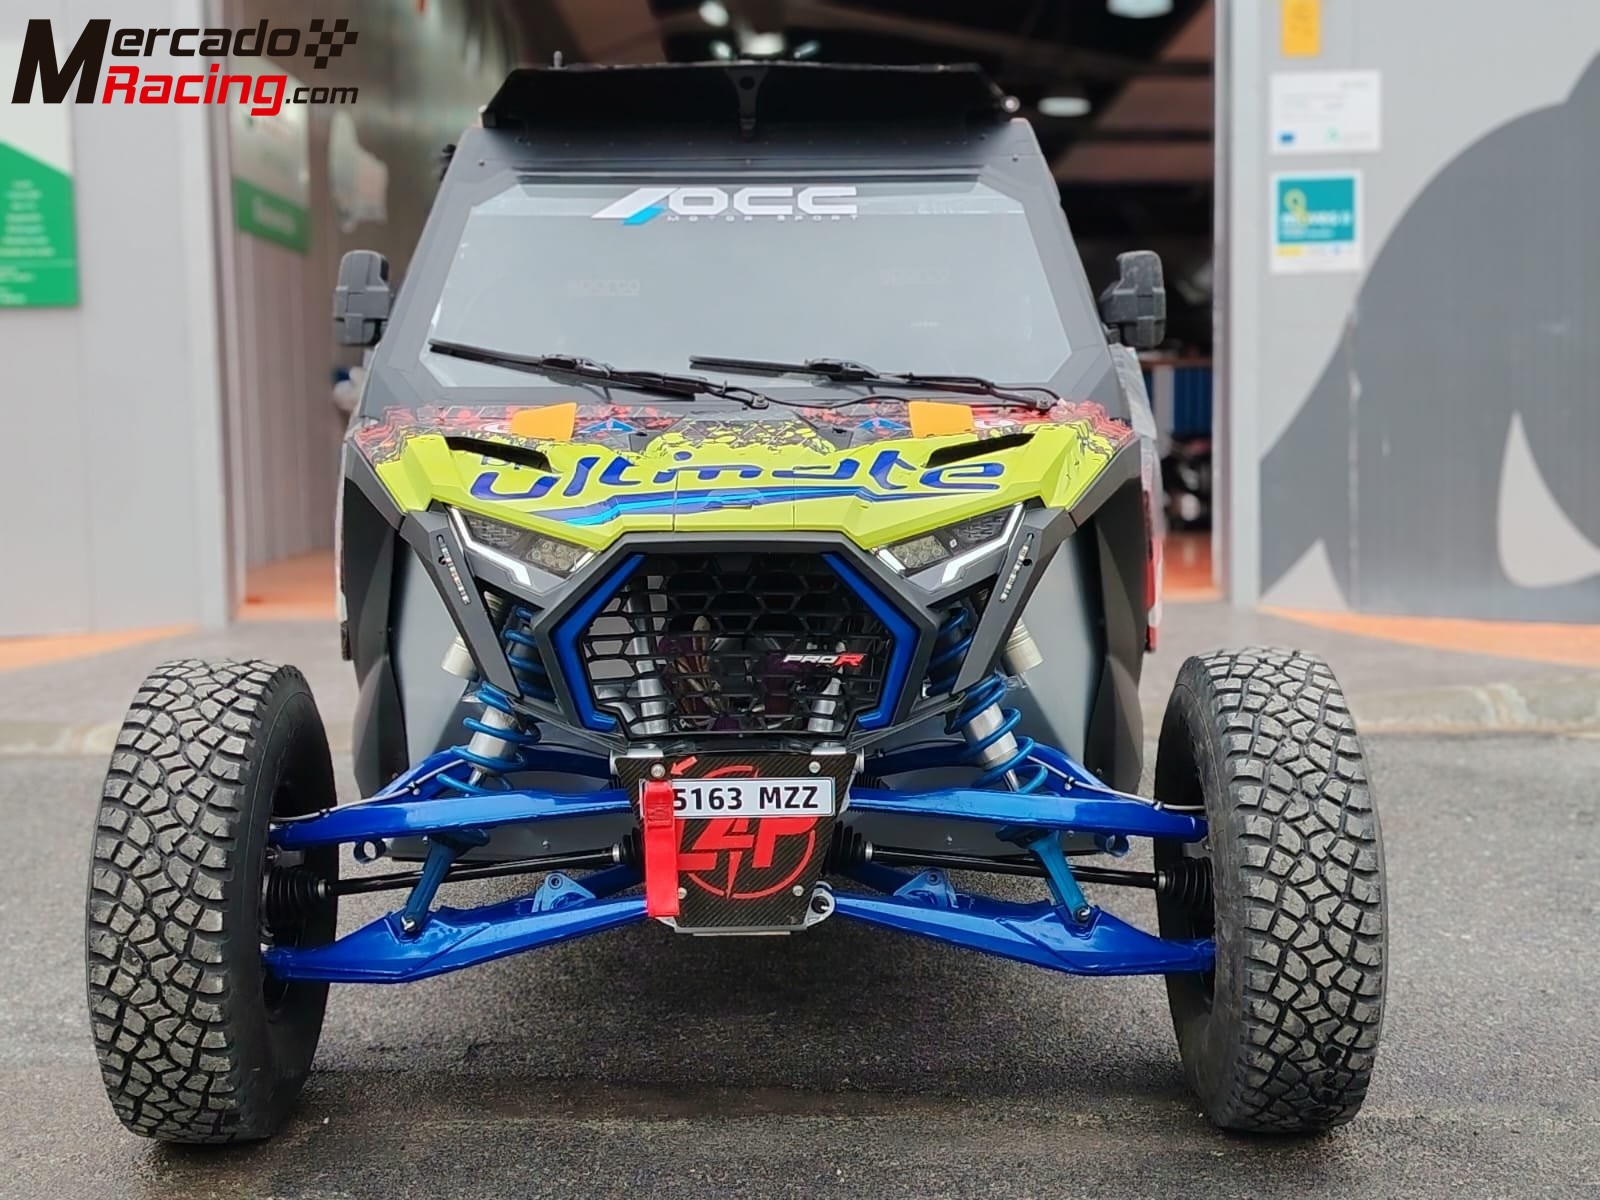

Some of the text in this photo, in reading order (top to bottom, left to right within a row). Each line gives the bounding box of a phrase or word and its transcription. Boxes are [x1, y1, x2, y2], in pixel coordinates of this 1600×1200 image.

[668, 187, 857, 215] OCC
[673, 786, 819, 811] 5163 MZZ
